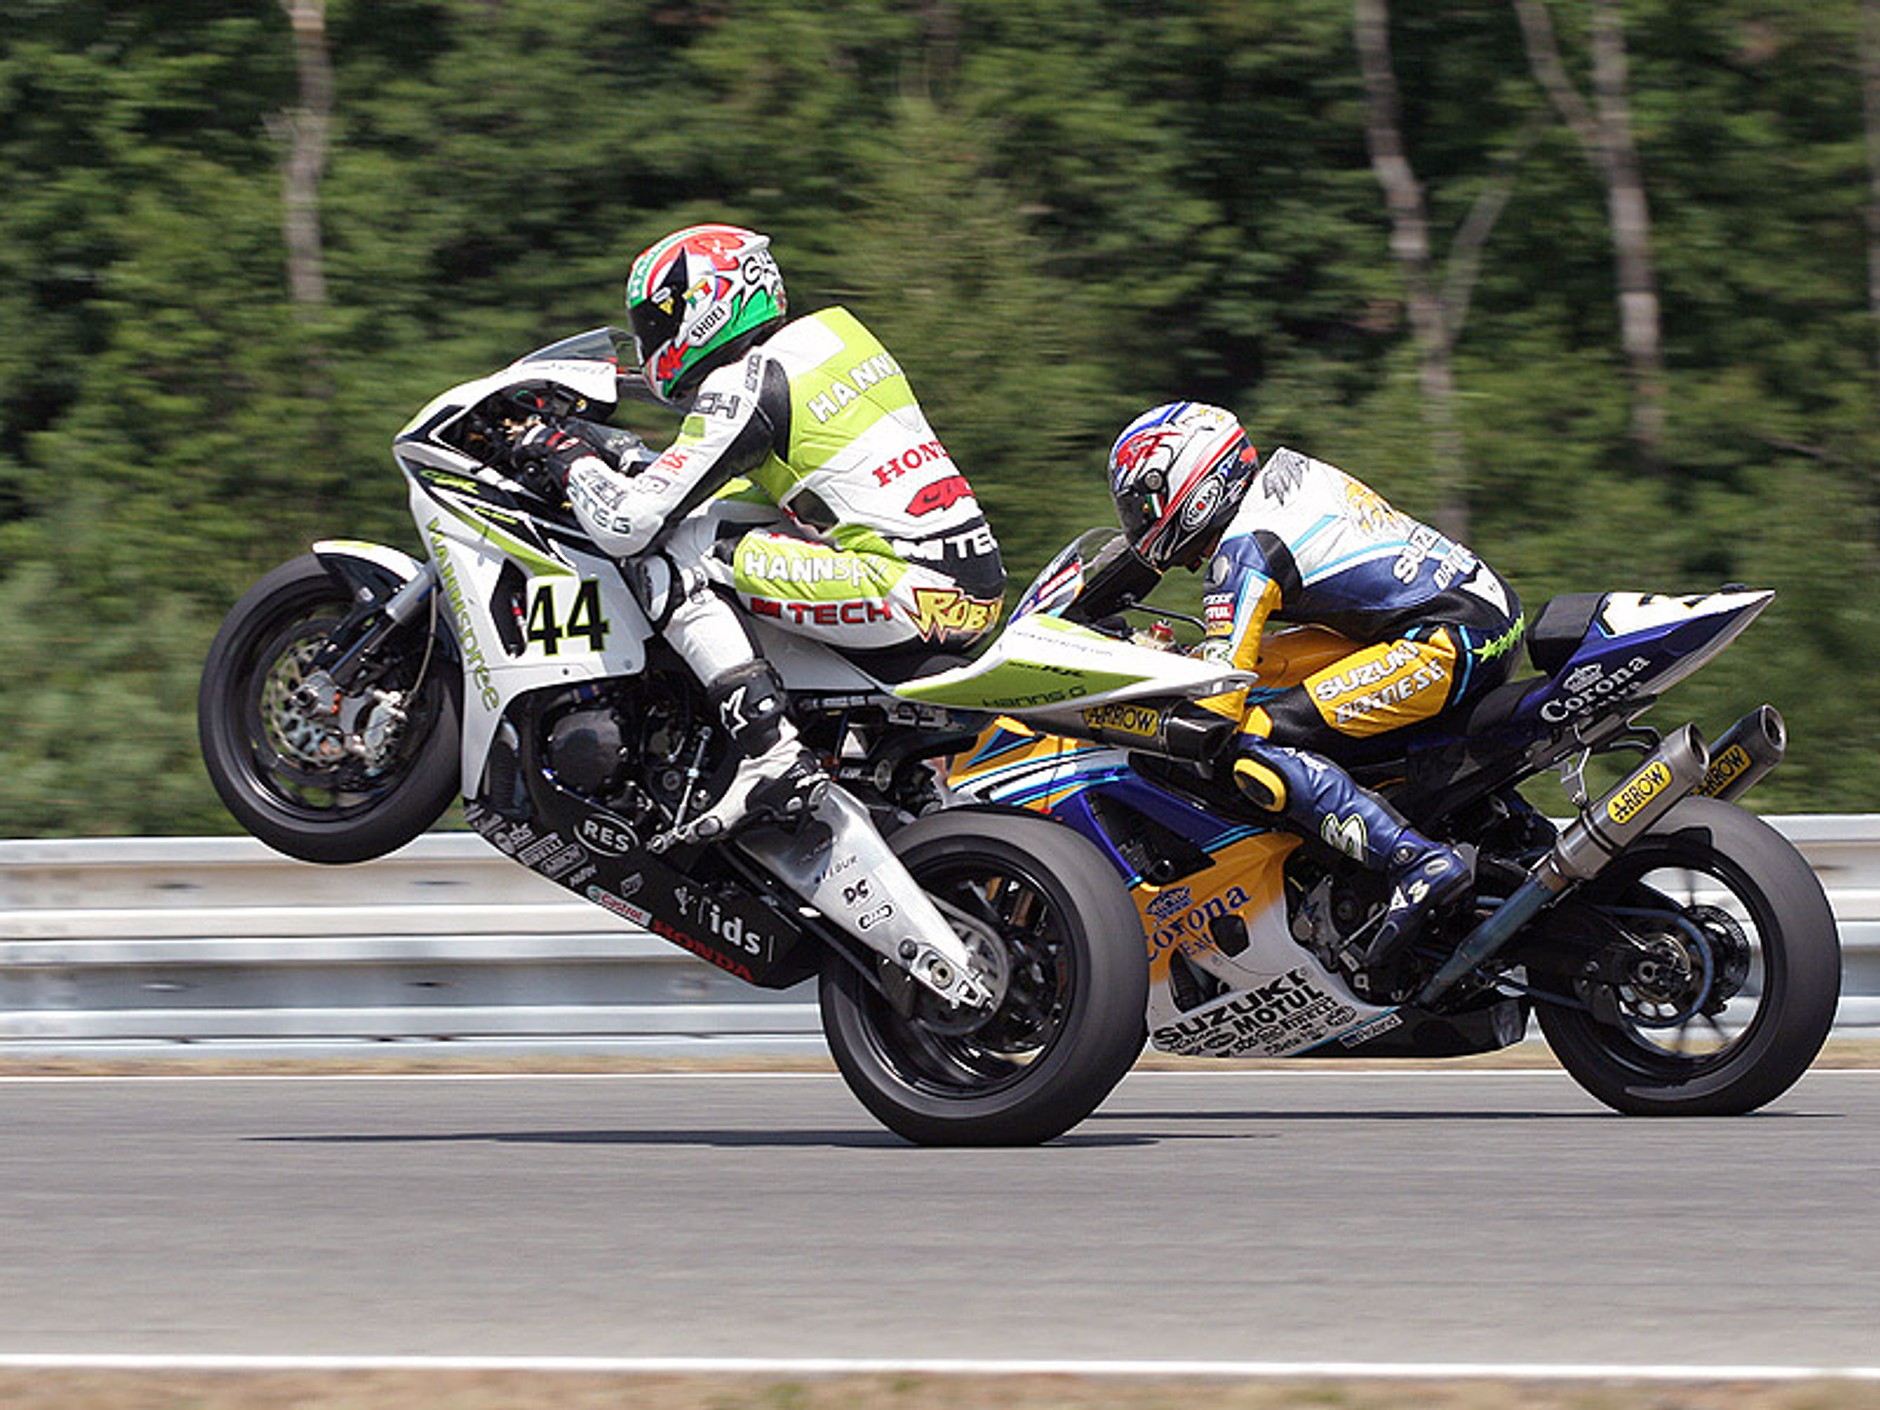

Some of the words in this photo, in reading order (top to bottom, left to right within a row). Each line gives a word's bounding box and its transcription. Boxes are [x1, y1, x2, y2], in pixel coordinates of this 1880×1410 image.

[526, 579, 610, 657] 44
[1541, 656, 1651, 723] Corona
[1612, 762, 1665, 821] ARROW
[583, 819, 630, 852] RES
[653, 918, 756, 983] HONDA
[709, 904, 761, 955] ids
[1153, 969, 1309, 1044] SUZUKI
[1232, 984, 1325, 1035] MOTUL
